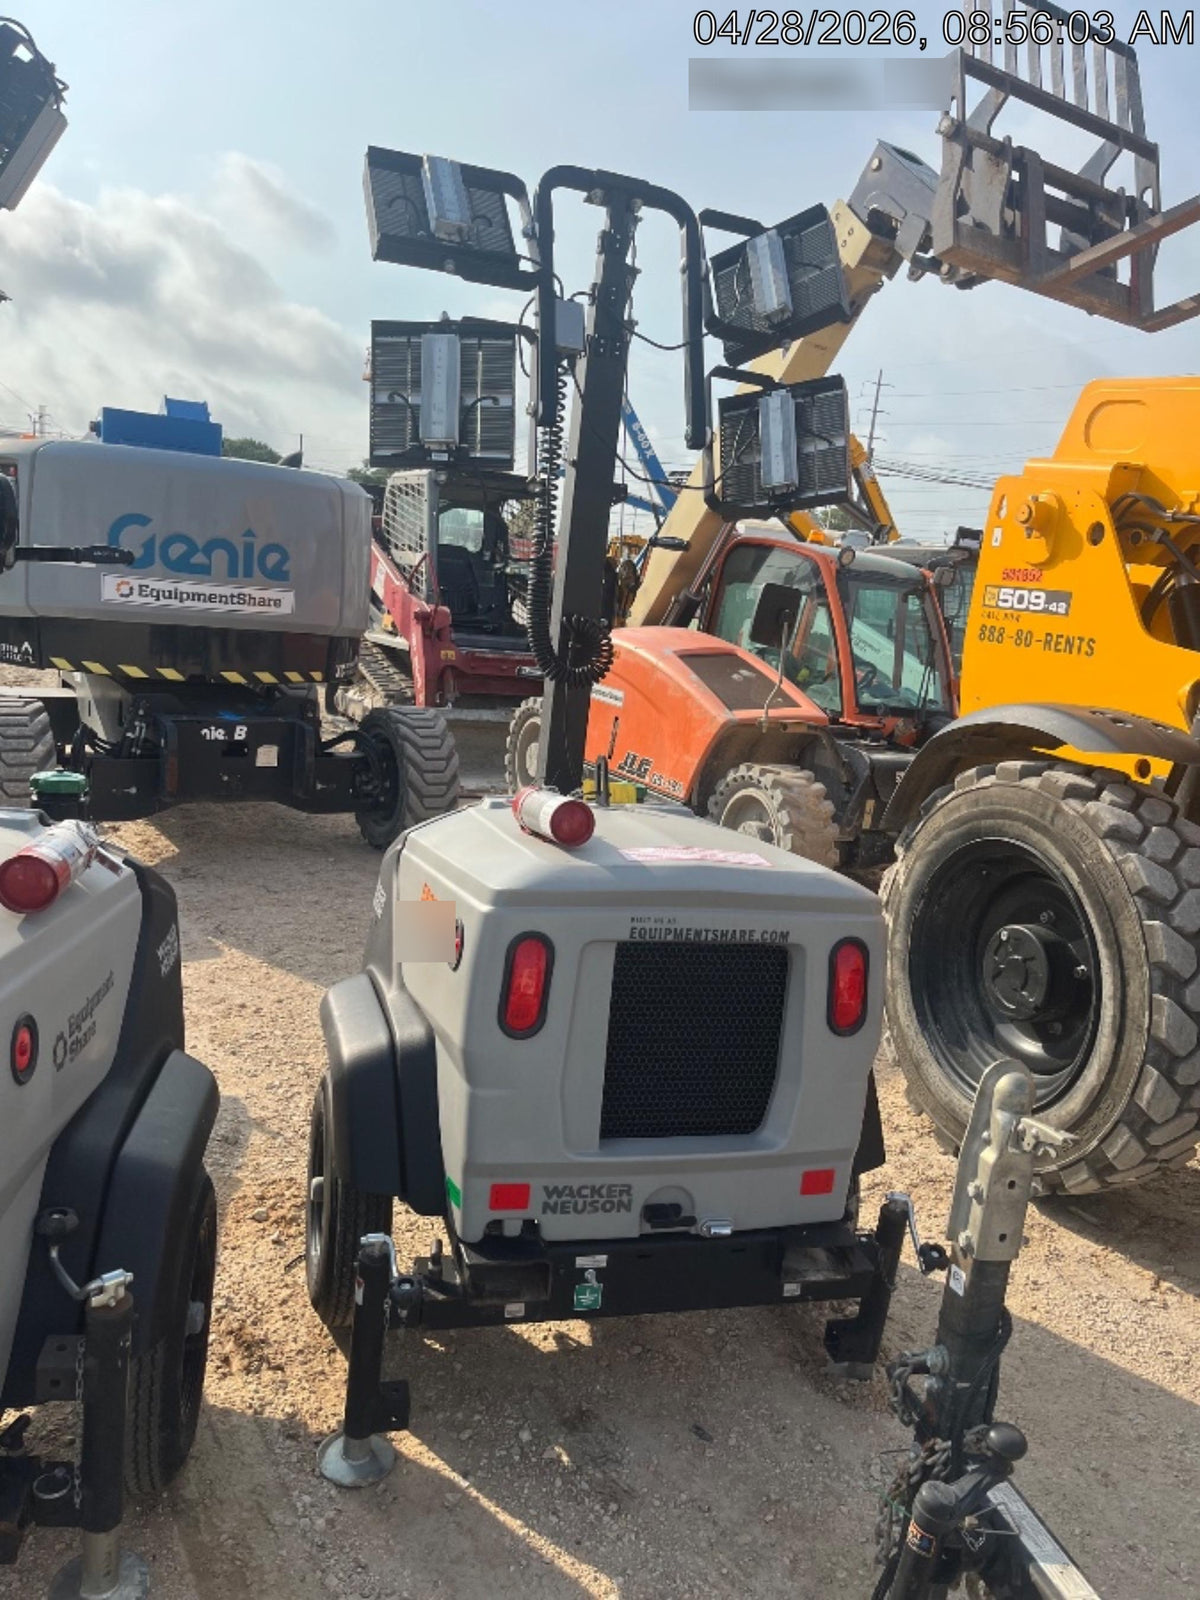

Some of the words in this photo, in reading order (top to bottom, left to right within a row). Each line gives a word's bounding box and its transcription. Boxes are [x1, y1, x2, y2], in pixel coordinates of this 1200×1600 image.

[107, 513, 290, 582] Genie
[137, 583, 283, 609] EquipmentShare
[978, 623, 1096, 657] 888-80-RENTS
[629, 926, 790, 943] EQUIPMENTSHARE.COM
[542, 1183, 633, 1199] WACKER
[541, 1199, 633, 1215] NEUSON
